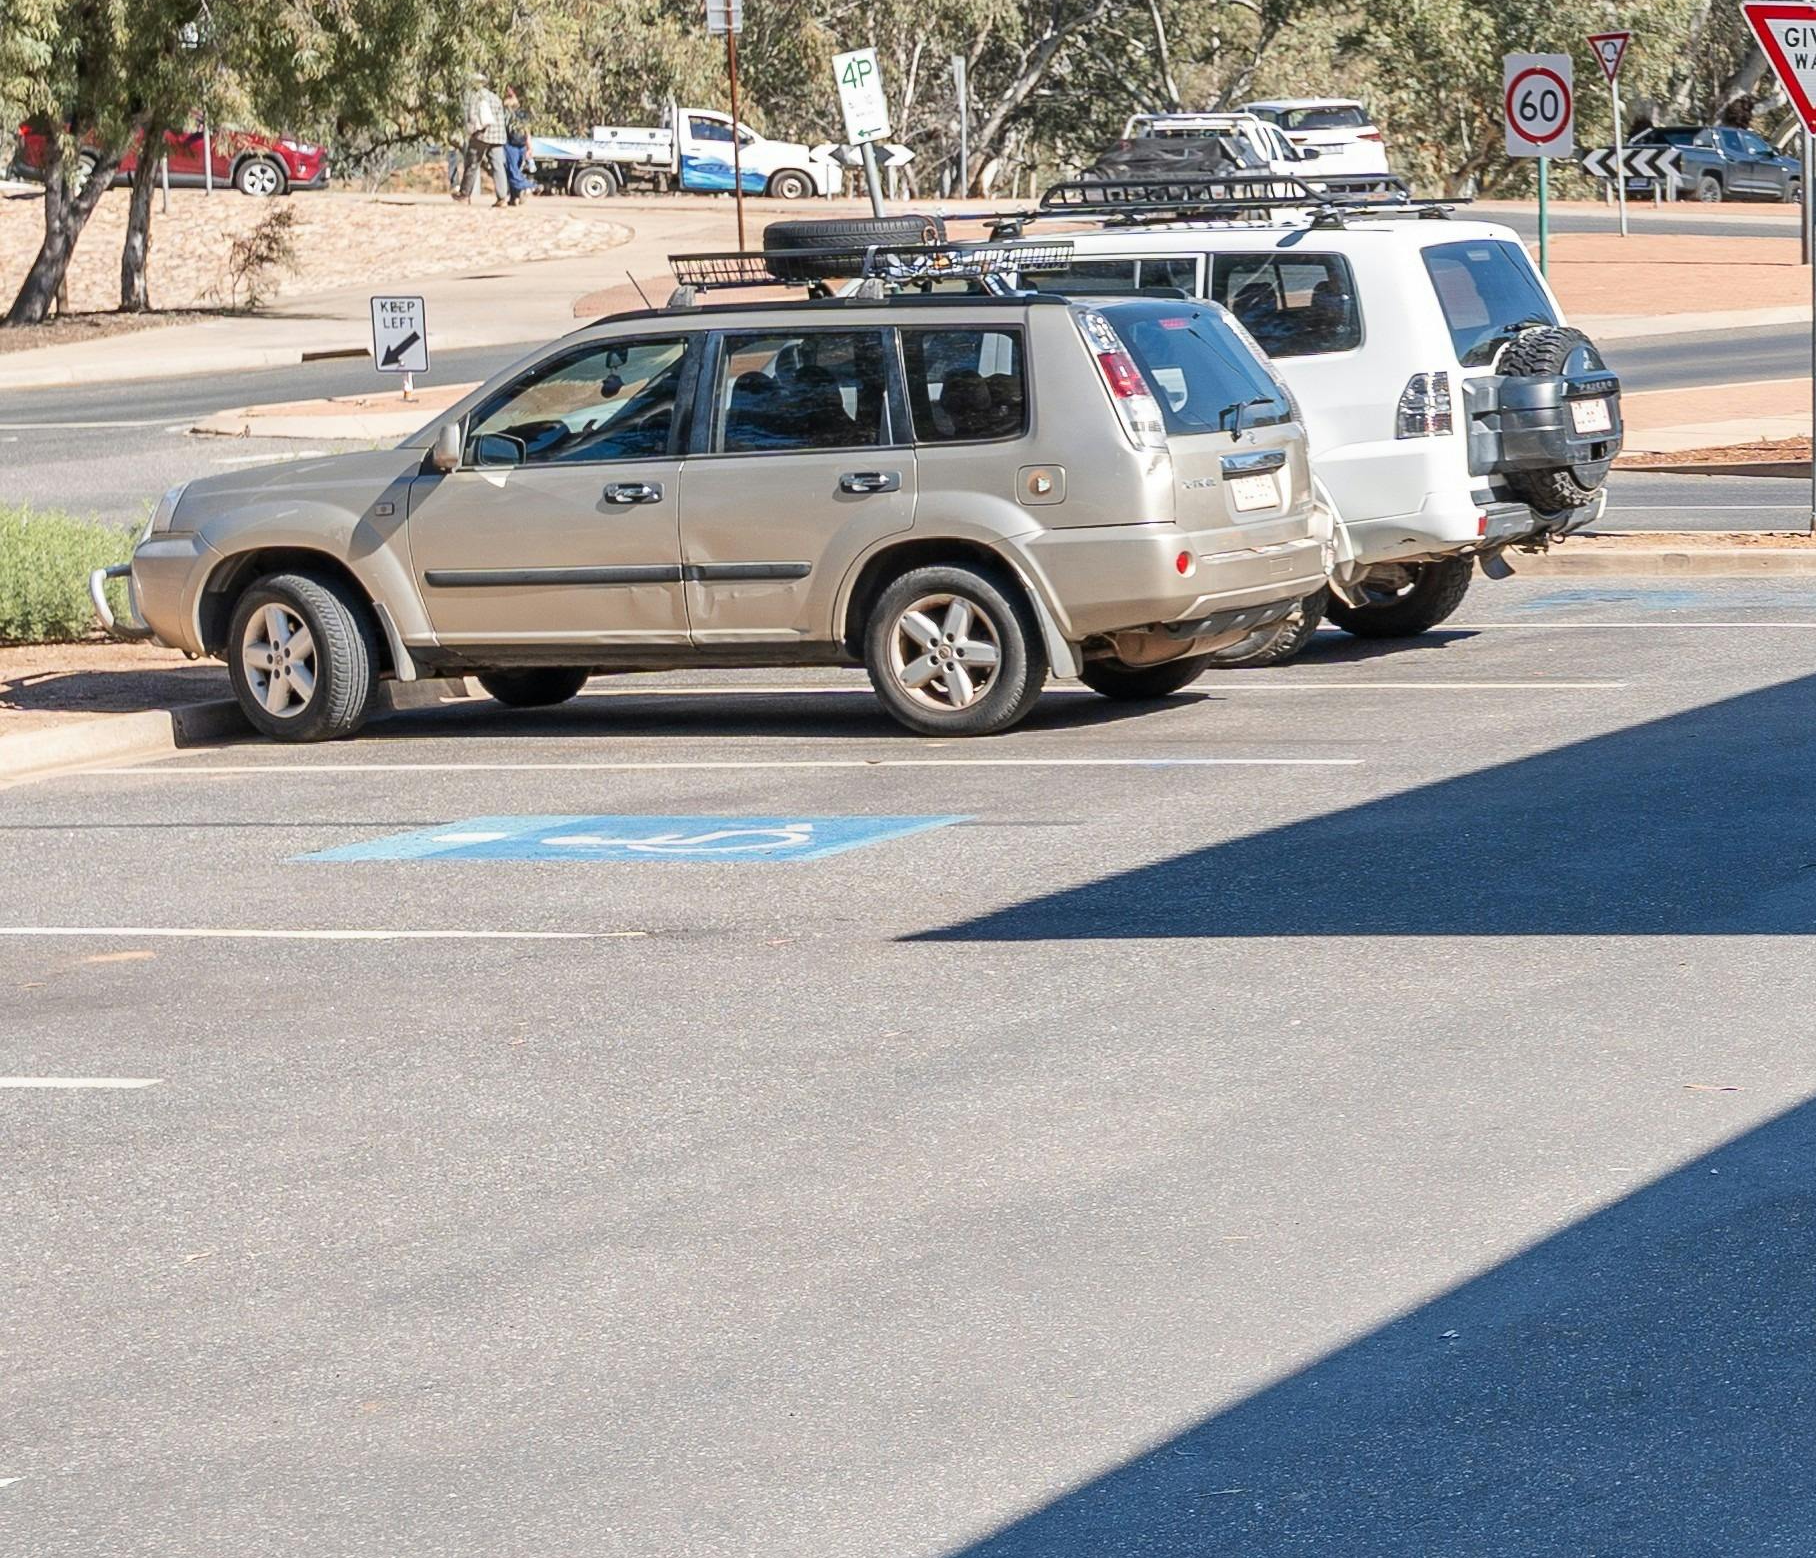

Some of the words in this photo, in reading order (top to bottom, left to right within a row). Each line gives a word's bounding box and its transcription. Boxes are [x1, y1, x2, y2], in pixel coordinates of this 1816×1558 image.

[842, 59, 873, 89] 4P
[1519, 89, 1559, 122] 60
[380, 301, 416, 314] KEEP
[383, 316, 415, 330] LEFT
